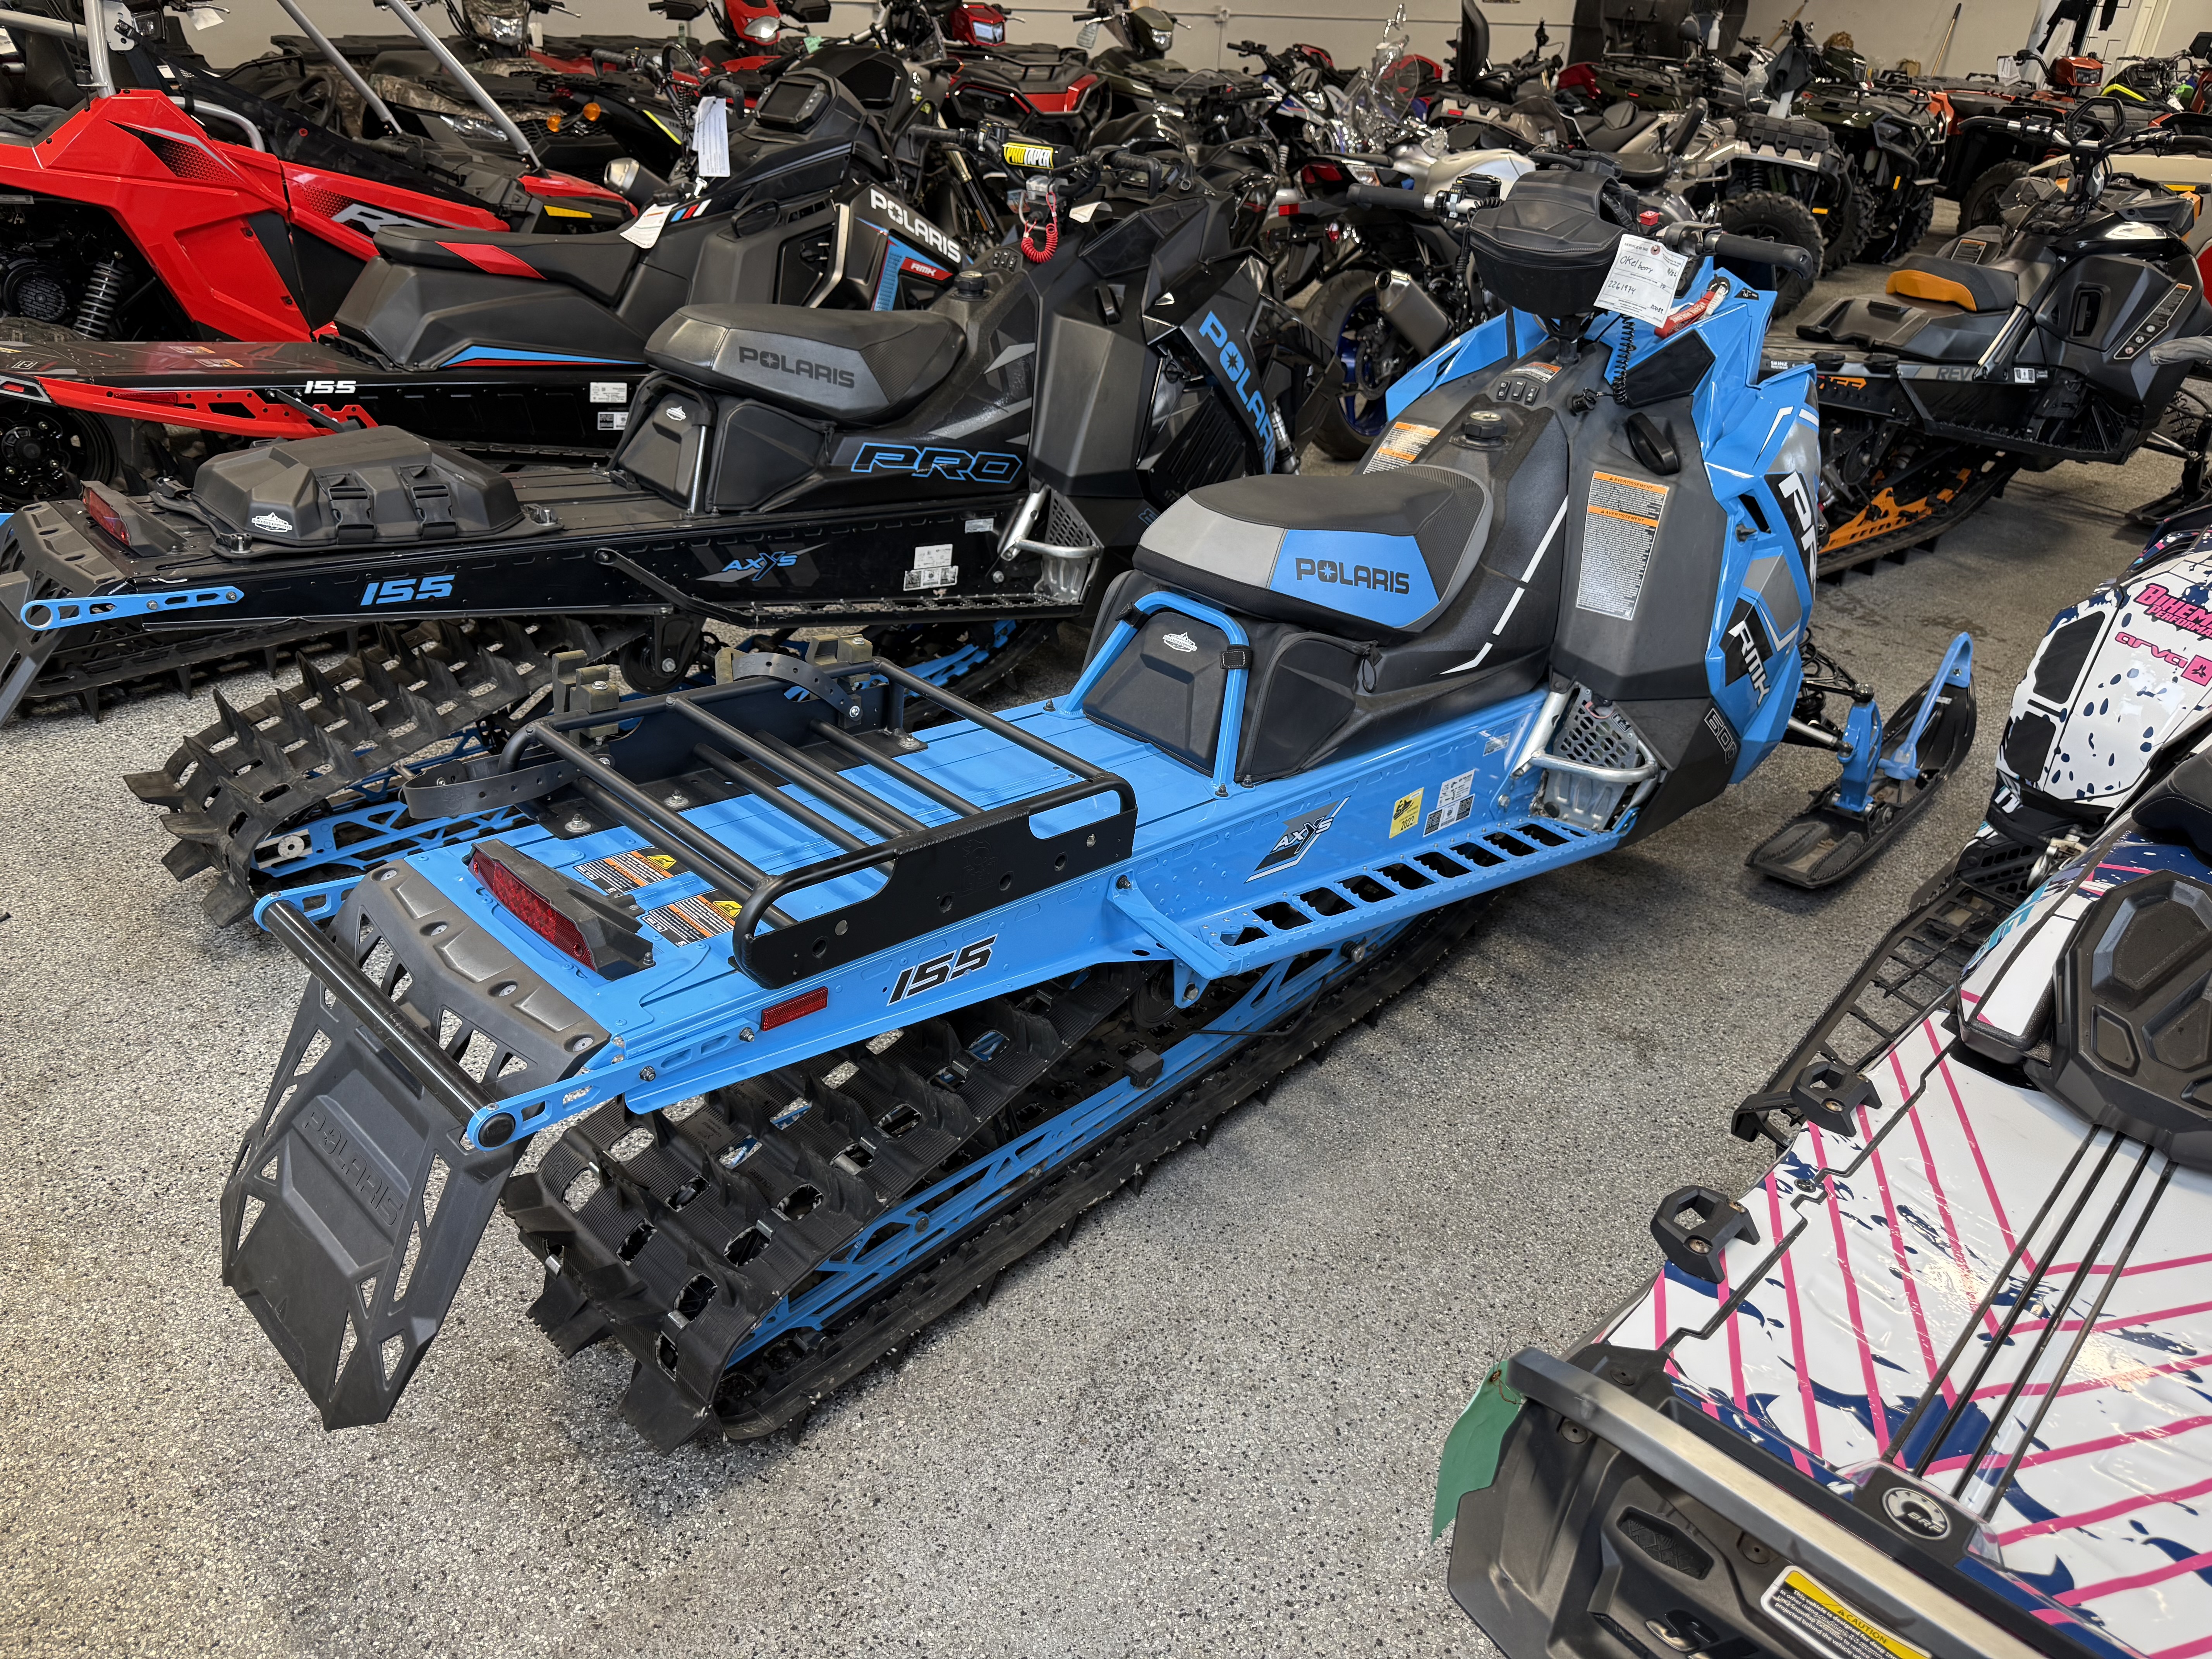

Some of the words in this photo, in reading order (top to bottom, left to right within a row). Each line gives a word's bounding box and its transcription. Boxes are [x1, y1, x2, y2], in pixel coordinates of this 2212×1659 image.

[870, 188, 962, 264] POLARIS
[910, 262, 938, 277] RMK
[738, 346, 855, 389] POLARIS
[304, 380, 357, 394] 155
[851, 441, 1024, 484] PRO
[1614, 477, 1653, 490] AVERTISSEMENT
[1605, 510, 1645, 523] AVERTISSEMENT
[721, 550, 798, 582] AXYS
[1295, 557, 1410, 595] POLARIS
[360, 574, 456, 606] 155
[2136, 584, 2212, 629] BIKEM
[2146, 605, 2212, 638] PERFORMA
[1728, 620, 1771, 708] RMK
[2114, 632, 2189, 669] arva
[1704, 707, 1737, 764] 600
[1272, 815, 1334, 855] AXYS
[1400, 815, 1414, 831] 2022
[616, 864, 638, 881] WARNING
[886, 934, 998, 1006] 155
[304, 1106, 404, 1226] POLARIS
[1907, 1511, 1943, 1534] BRP
[1786, 1594, 1802, 1606] other
[1802, 1604, 1819, 1618] riding
[1793, 1589, 1806, 1601] This
[1806, 1599, 1827, 1614] vehicle
[1832, 1616, 1861, 1636] designed
[1860, 1633, 1870, 1642] for
[1869, 1641, 1887, 1654] deep
[1774, 1602, 1802, 1621] projected
[1802, 1618, 1823, 1634] behind
[1822, 1632, 1832, 1640] the
[1832, 1639, 1853, 1655] vehicle
[1777, 1595, 1791, 1606] LinQ
[1790, 1604, 1816, 1623] Snowflap
[1816, 1620, 1843, 1640] Extension
[1850, 1644, 1870, 1659] reduce
[1846, 1614, 1887, 1644] CAUTION
